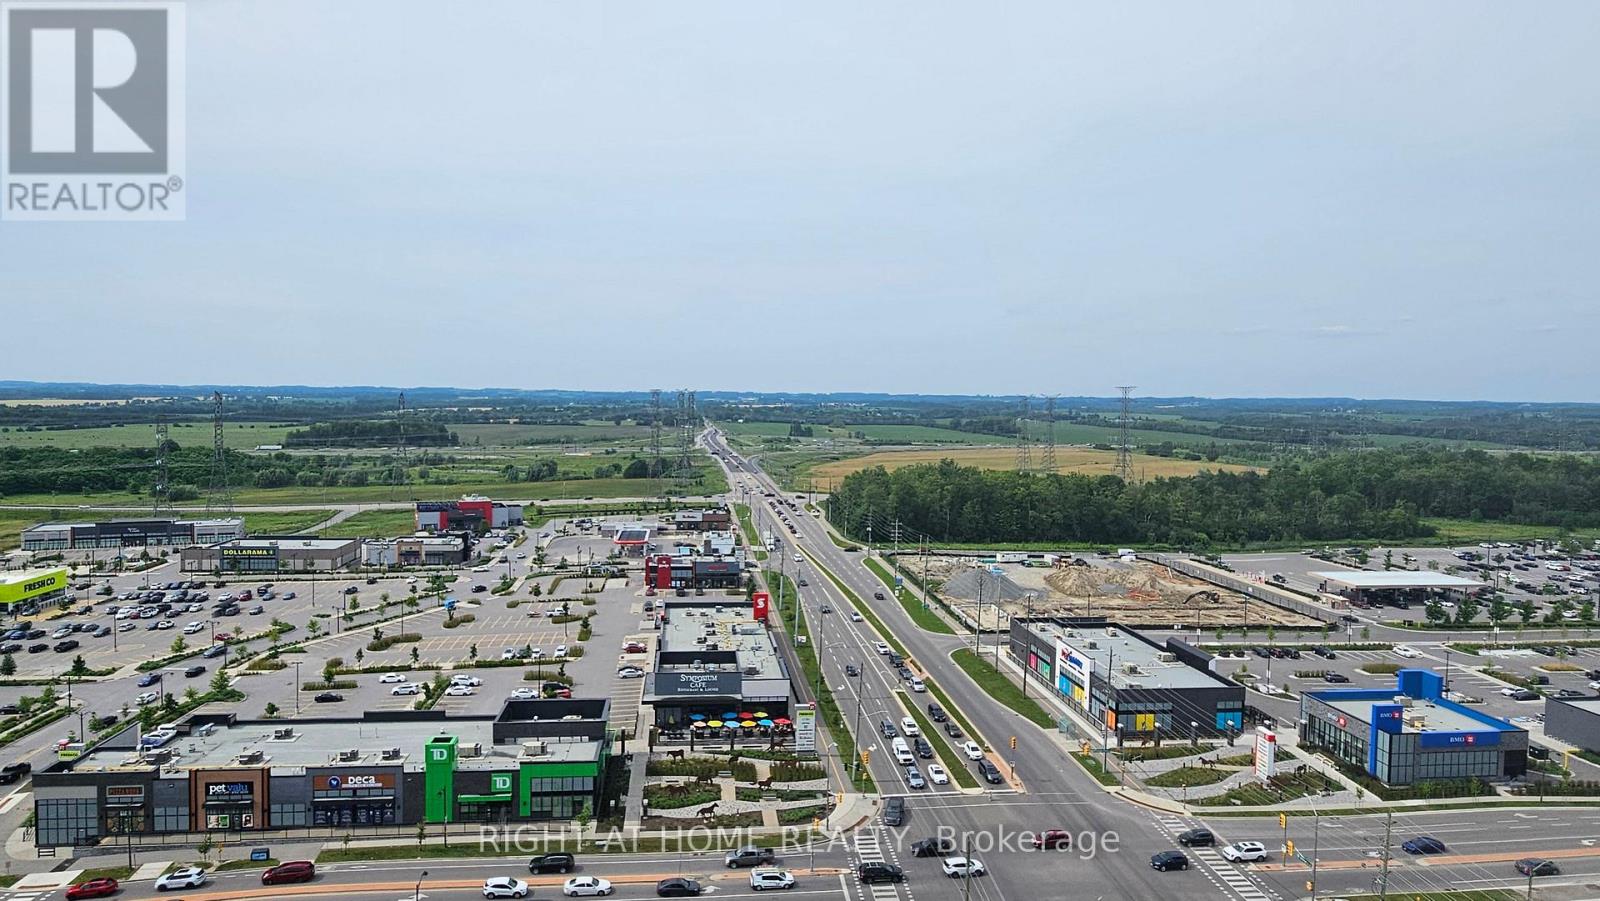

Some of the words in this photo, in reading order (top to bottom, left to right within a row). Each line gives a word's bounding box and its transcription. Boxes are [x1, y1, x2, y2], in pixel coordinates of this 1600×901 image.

[680, 674, 718, 682] SYMPOSIUM
[430, 748, 448, 761] TD
[209, 784, 226, 795] pet
[227, 783, 248, 791] valu
[493, 777, 510, 789] TD
